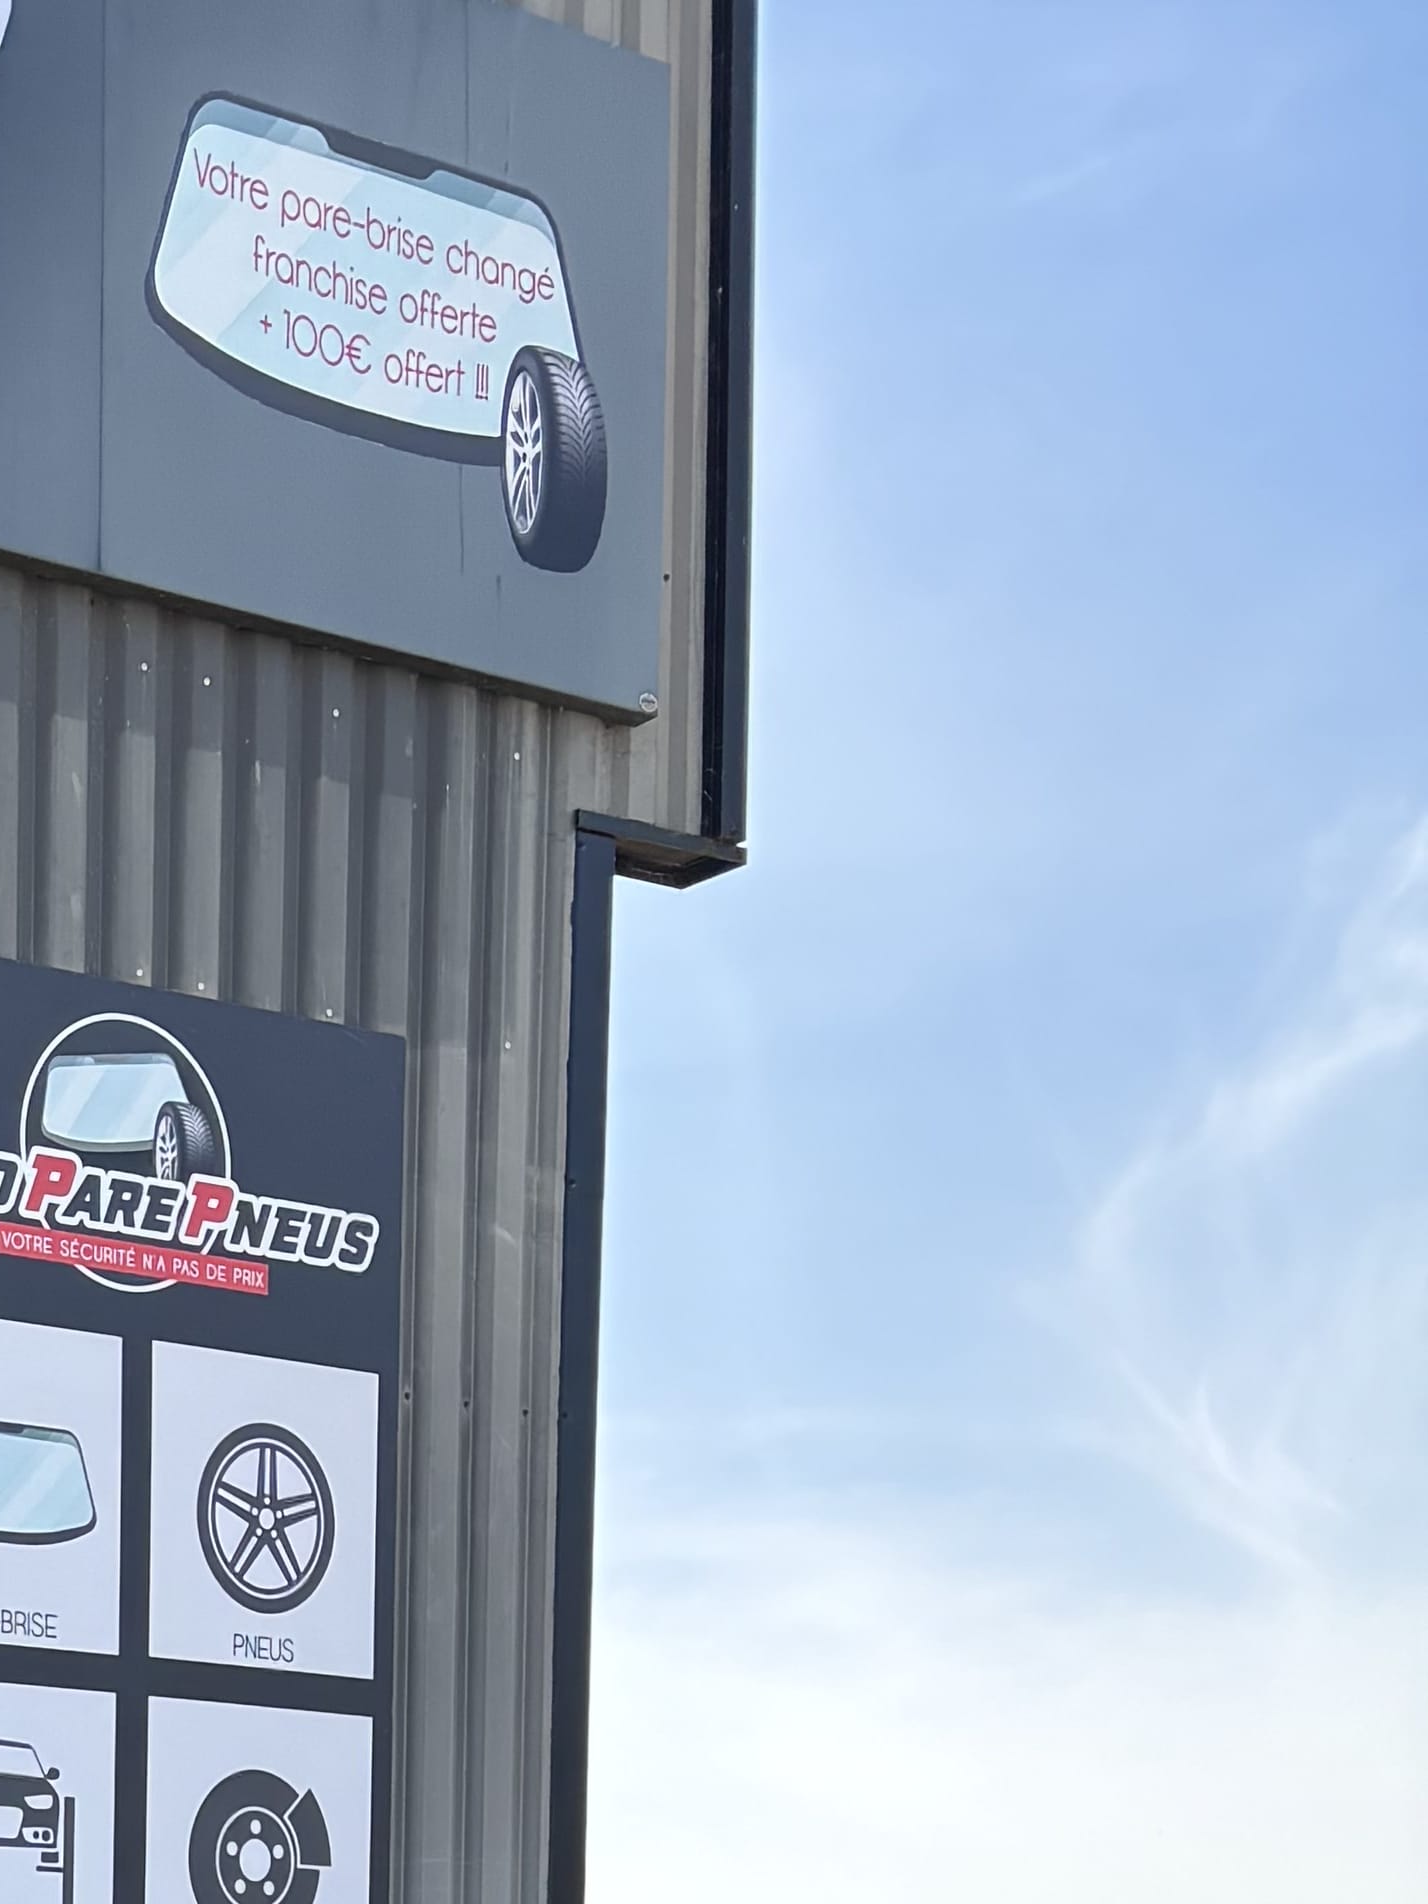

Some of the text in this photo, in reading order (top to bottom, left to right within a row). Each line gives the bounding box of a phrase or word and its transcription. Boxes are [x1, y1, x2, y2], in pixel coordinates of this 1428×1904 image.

[193, 147, 555, 304] Votre pare-brise changé
[253, 235, 497, 343] franchise offerte
[283, 309, 372, 374] 100€
[384, 349, 466, 396] offert
[22, 1150, 182, 1234] PARE
[182, 1177, 377, 1269] PNEUS
[2, 1231, 52, 1254] VOTRE
[60, 1239, 135, 1267] SÉCURITÉ
[173, 1258, 199, 1277] PAS
[206, 1263, 226, 1282] DE
[233, 1268, 264, 1289] PRIX
[233, 1633, 294, 1663] PNEUS
